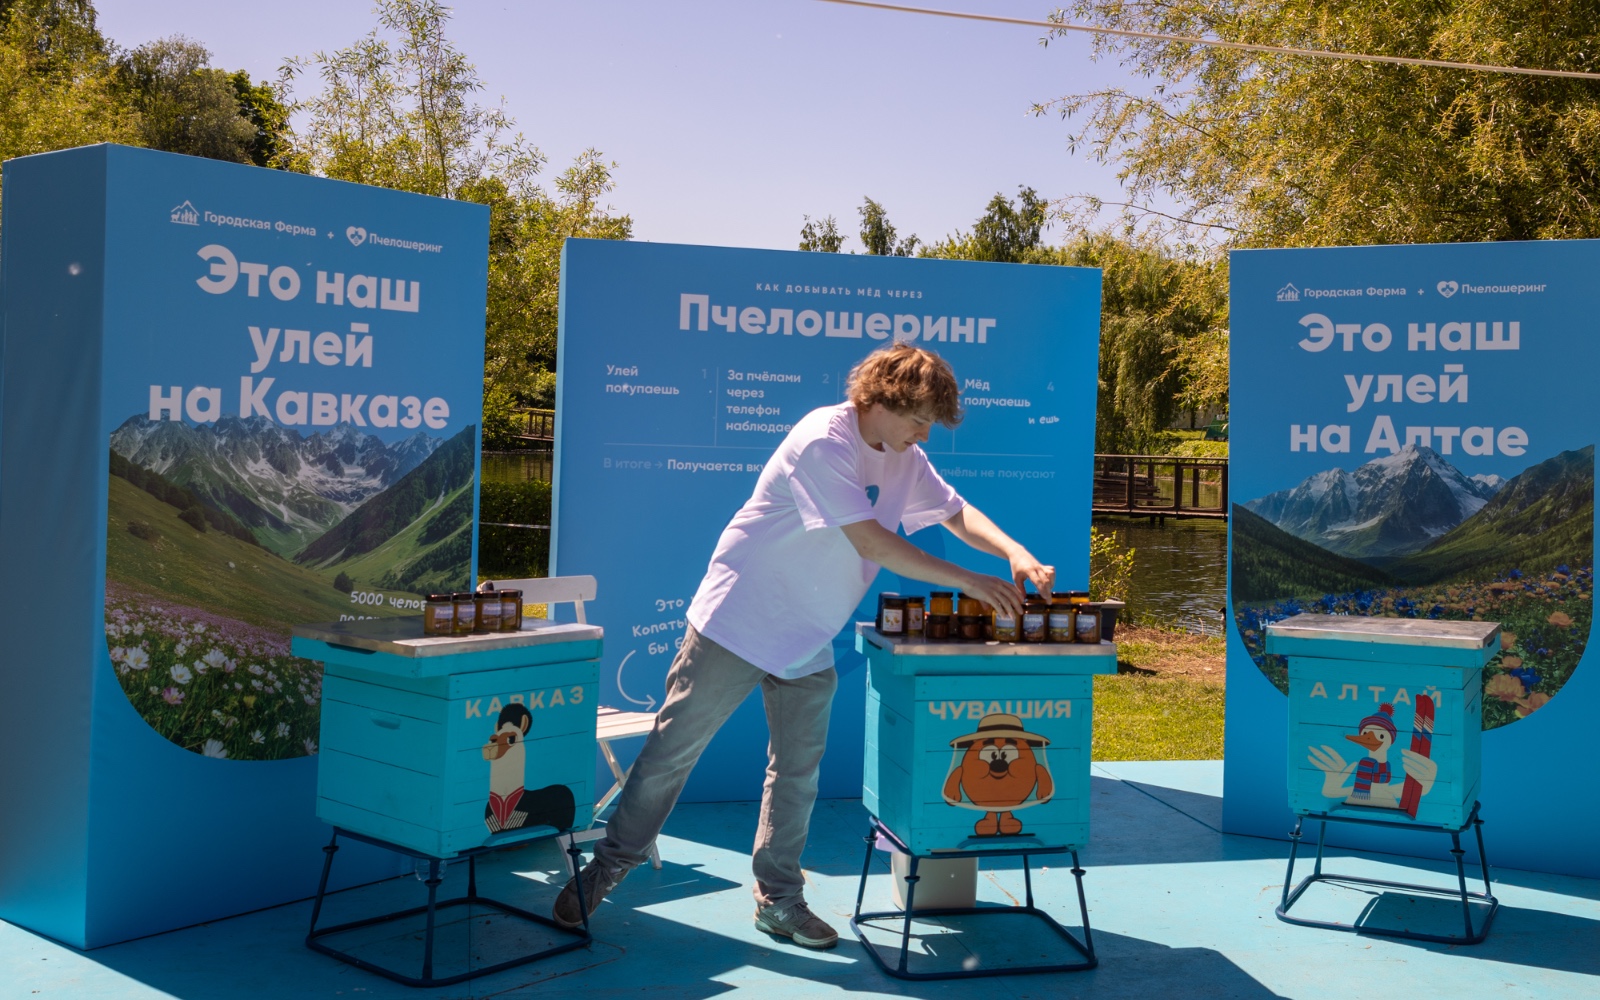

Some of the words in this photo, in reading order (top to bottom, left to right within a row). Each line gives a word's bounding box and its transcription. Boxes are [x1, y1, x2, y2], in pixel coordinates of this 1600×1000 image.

[204, 210, 271, 230] Городская
[274, 219, 317, 236] Ферма
[369, 233, 443, 253] Пчелошеринг
[196, 244, 300, 300] Это
[316, 270, 420, 313] наш
[756, 283, 780, 292] КАК
[785, 284, 851, 296] ДОБЫВАТЬ
[857, 287, 881, 298] МЁД
[887, 290, 923, 299] ЧЕРЕЗ
[1303, 286, 1363, 299] Городская
[1365, 285, 1407, 298] Ферма
[1460, 282, 1548, 295] Пчелошеринг
[679, 293, 996, 344] Пчелошеринг
[1298, 313, 1393, 352] Это
[1407, 321, 1520, 351] наш
[248, 322, 373, 373] улей
[606, 364, 638, 377] Улей
[727, 369, 743, 381] За
[746, 369, 801, 383] пчёлами
[605, 383, 680, 396] покупаешь
[726, 388, 765, 399] через
[964, 378, 991, 392] Мёд
[1344, 364, 1468, 412] улей
[149, 384, 222, 423] на
[239, 376, 450, 429] Кавказе
[725, 403, 781, 418] телефон
[964, 397, 1031, 408] получаешь
[725, 420, 793, 434] наблюдае
[1039, 416, 1060, 425] ешь
[1290, 423, 1351, 453] на
[1364, 415, 1529, 457] Алтае
[603, 457, 612, 469] В
[616, 460, 651, 472] итоге
[666, 458, 744, 474] Получается
[980, 468, 995, 479] не
[997, 469, 1056, 481] покусают
[350, 591, 384, 607] 5000
[389, 596, 427, 612] челов
[655, 599, 684, 612] Это
[632, 618, 688, 637] Копаты
[465, 686, 584, 719] КАВКАЗ
[1309, 681, 1442, 708] АЛТАЙ
[928, 700, 1071, 720] ЧУВАШИЯ
